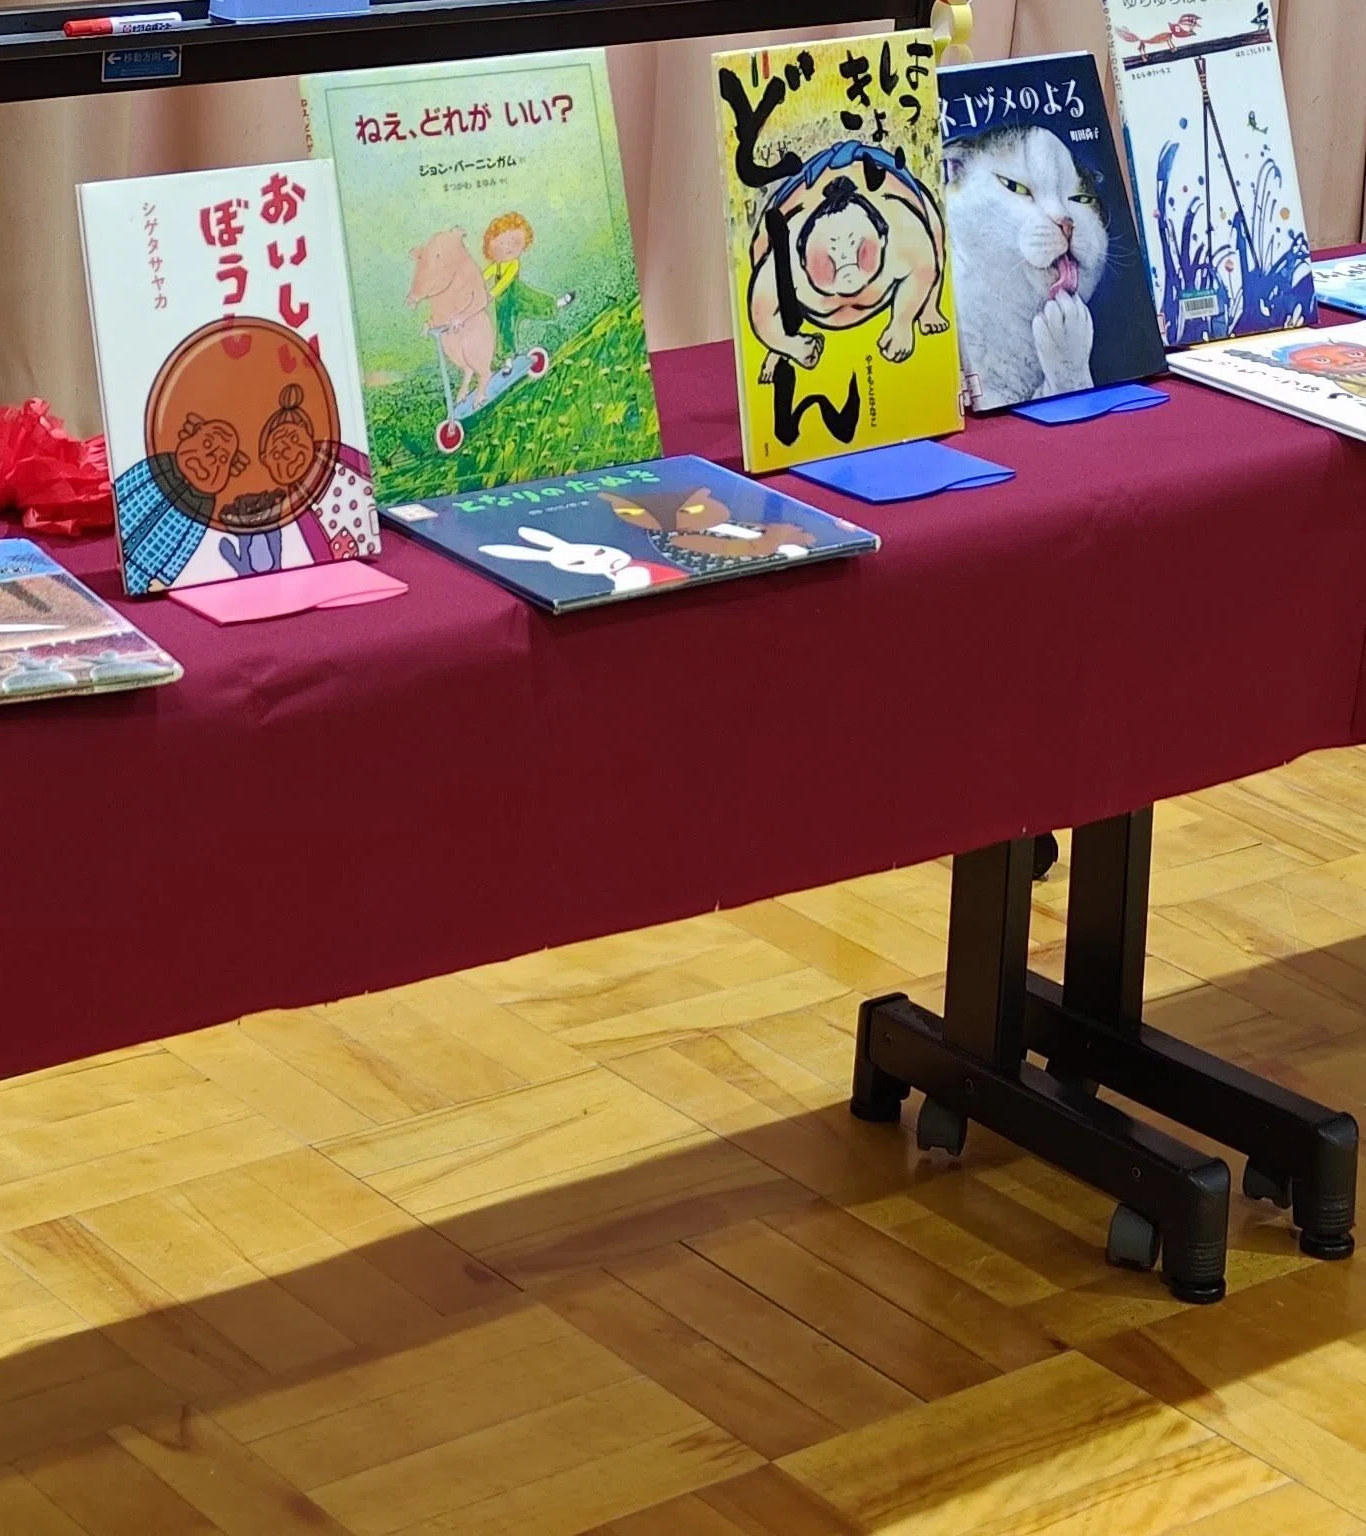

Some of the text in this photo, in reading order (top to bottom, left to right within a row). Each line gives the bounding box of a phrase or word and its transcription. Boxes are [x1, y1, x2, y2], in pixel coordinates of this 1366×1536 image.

[355, 102, 491, 145] ねえ、どれが
[938, 77, 1087, 140] ネコヅメのよる
[419, 155, 517, 176] ジョン・バーニンガム
[142, 201, 168, 311] シゲタサヤカ
[199, 198, 253, 360] ぼうし
[259, 171, 321, 375] おいしい
[719, 48, 863, 447] どーん
[451, 468, 662, 514] となりのたぬき
